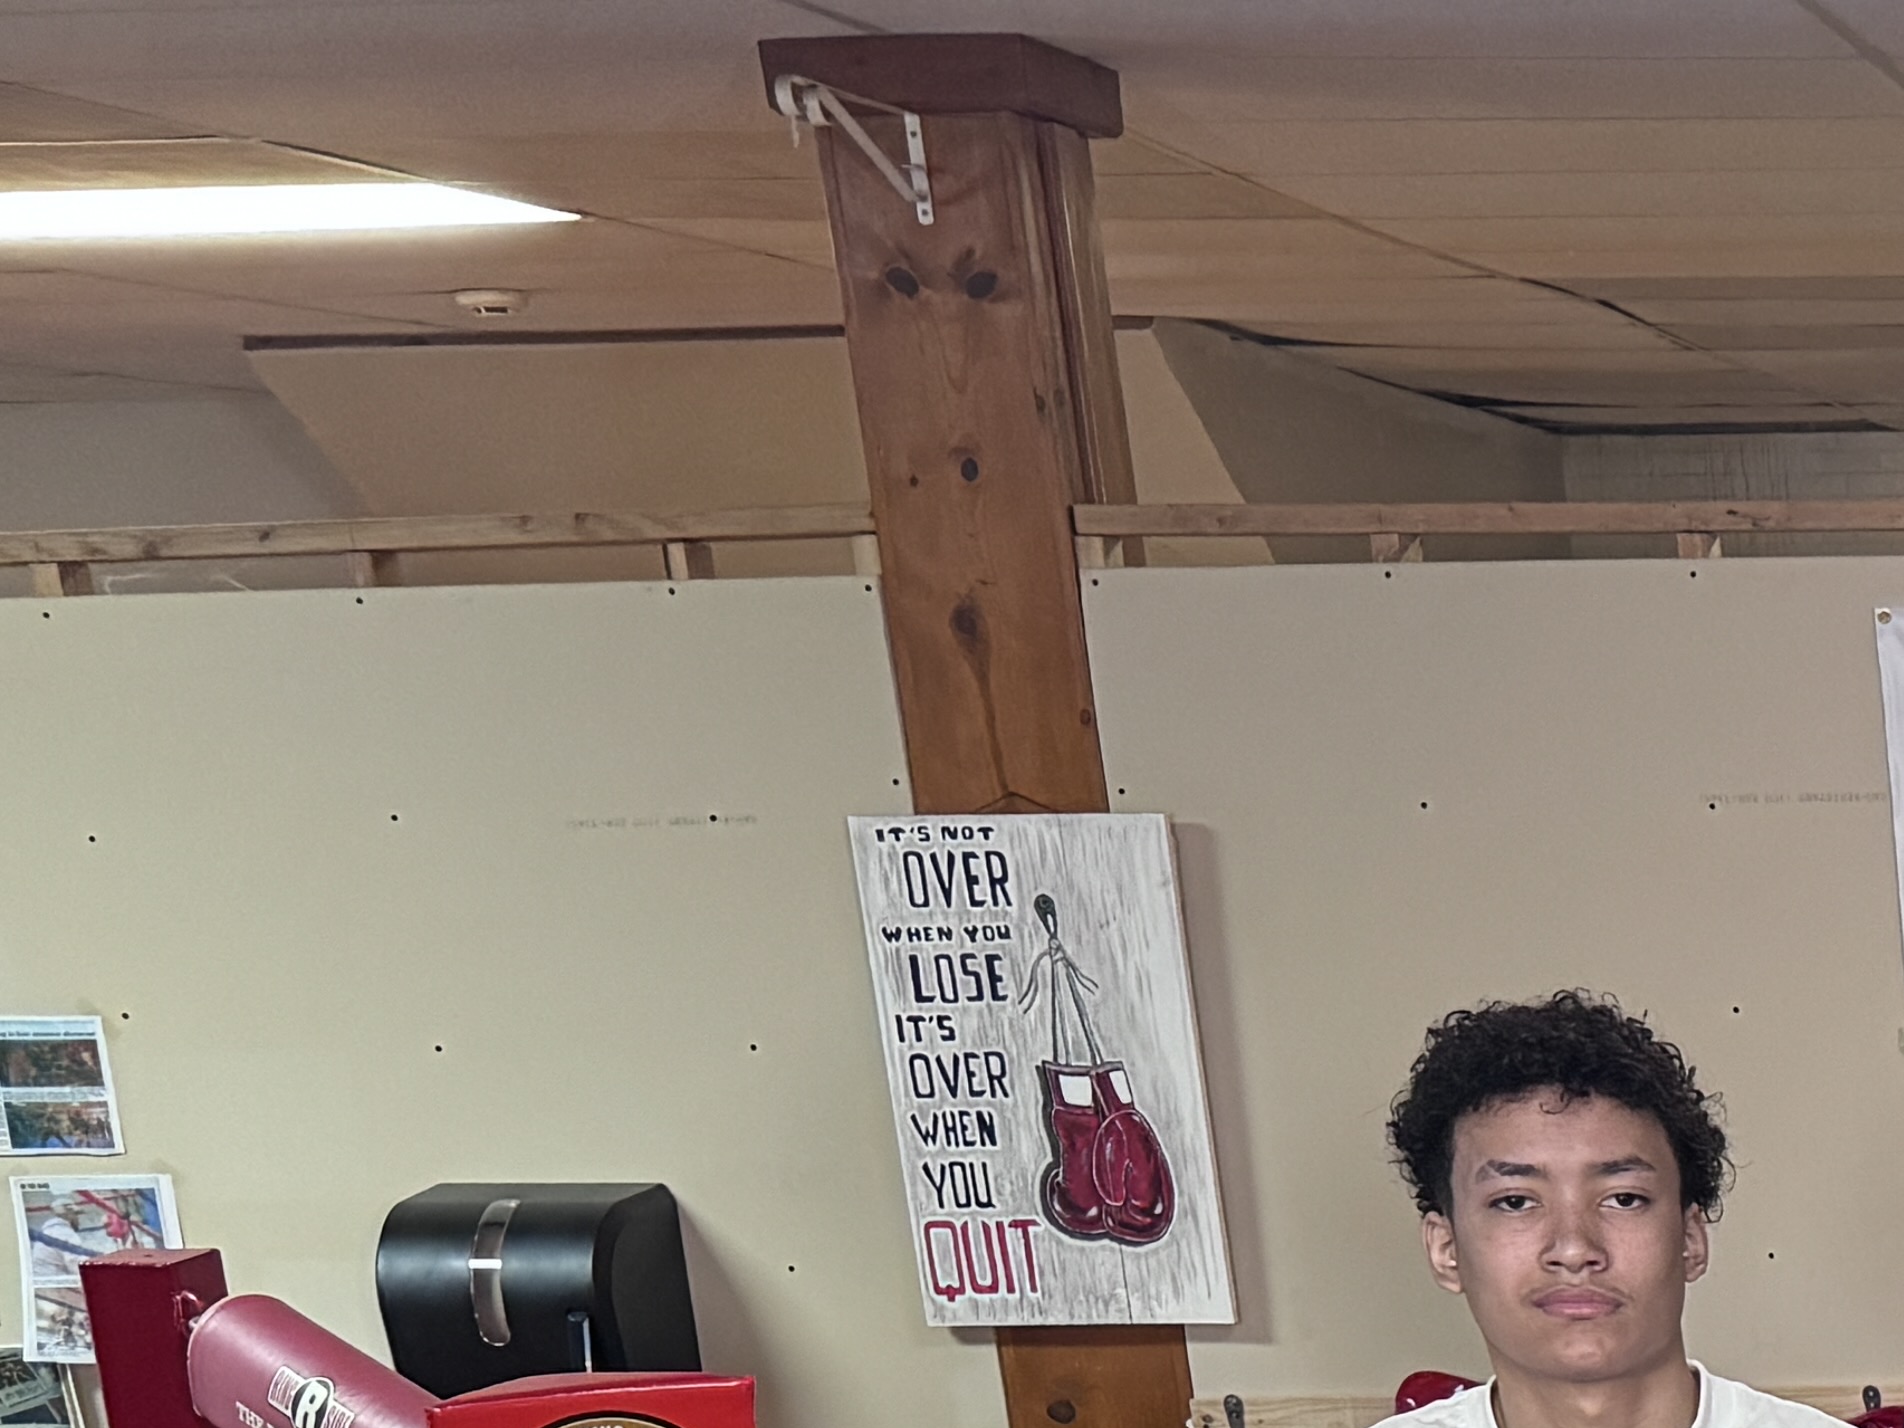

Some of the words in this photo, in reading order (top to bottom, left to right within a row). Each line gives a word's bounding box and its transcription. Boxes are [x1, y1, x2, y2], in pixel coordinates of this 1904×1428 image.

[876, 826, 930, 842] IT'S
[941, 826, 995, 841] NOT
[903, 849, 1013, 909] OVER
[881, 926, 953, 944] WHEN
[963, 926, 1012, 942] YOU
[909, 953, 1010, 1003] LOSE
[895, 1014, 956, 1042] IT'S
[908, 1050, 1011, 1100] OVER
[910, 1110, 998, 1148] WHEN
[922, 1161, 997, 1210] YOU
[923, 1219, 1042, 1302] QUIT
